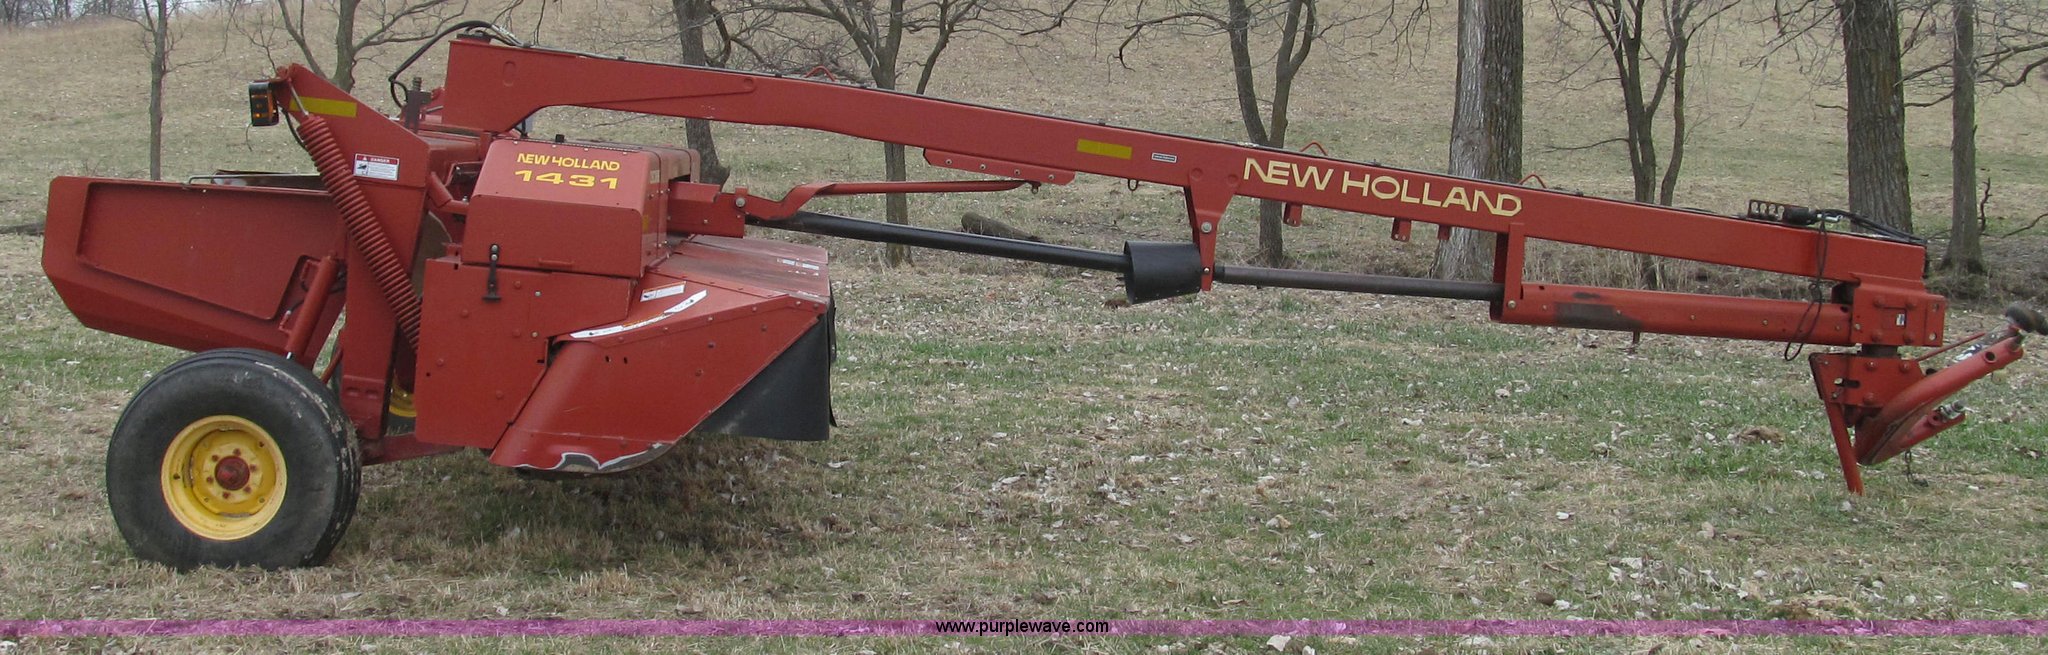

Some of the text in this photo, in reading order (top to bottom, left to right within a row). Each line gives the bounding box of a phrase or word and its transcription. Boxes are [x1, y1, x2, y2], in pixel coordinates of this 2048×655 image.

[517, 153, 620, 171] NEW HOLLAND
[515, 170, 618, 190] 1431
[1243, 157, 1523, 217] NEW HOLLAND
